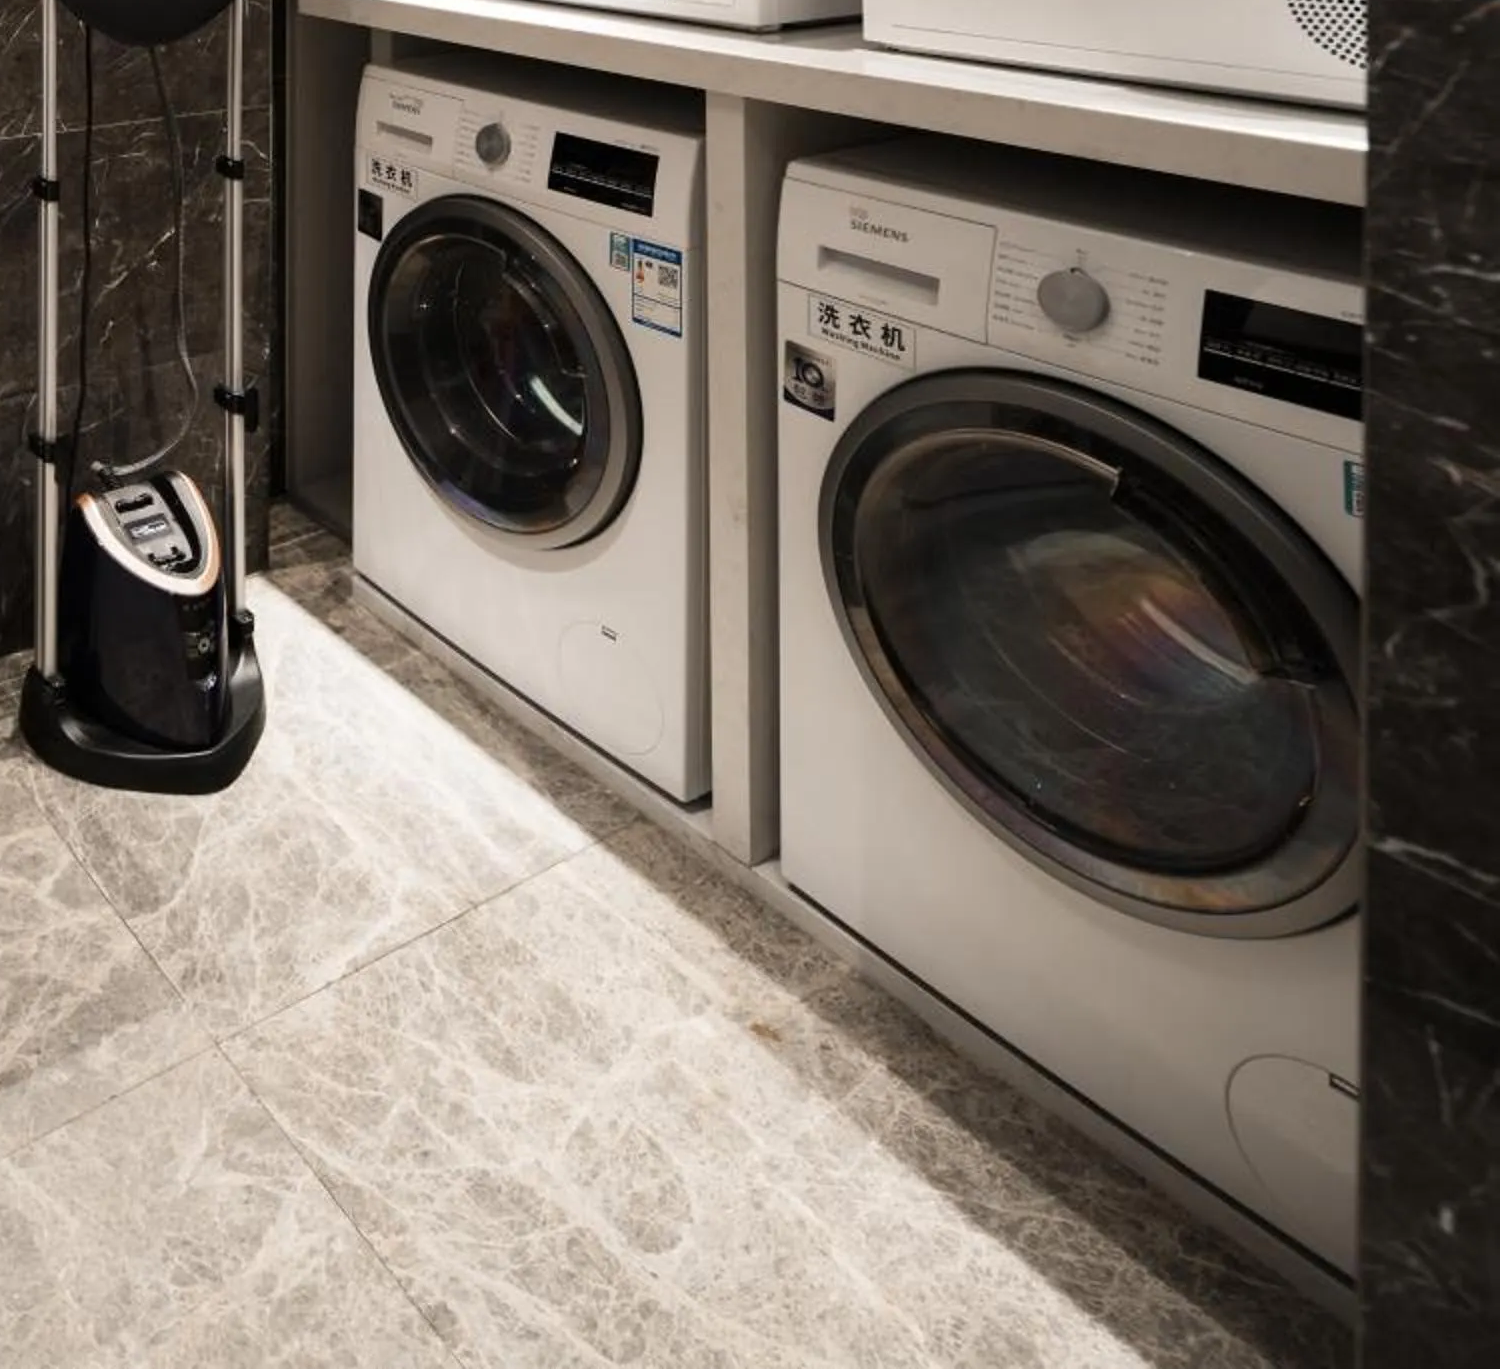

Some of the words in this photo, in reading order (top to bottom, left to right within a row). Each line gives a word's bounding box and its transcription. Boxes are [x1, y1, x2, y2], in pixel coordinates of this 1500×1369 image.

[851, 220, 910, 243] SIEMENS
[818, 301, 906, 352] 洗衣机
